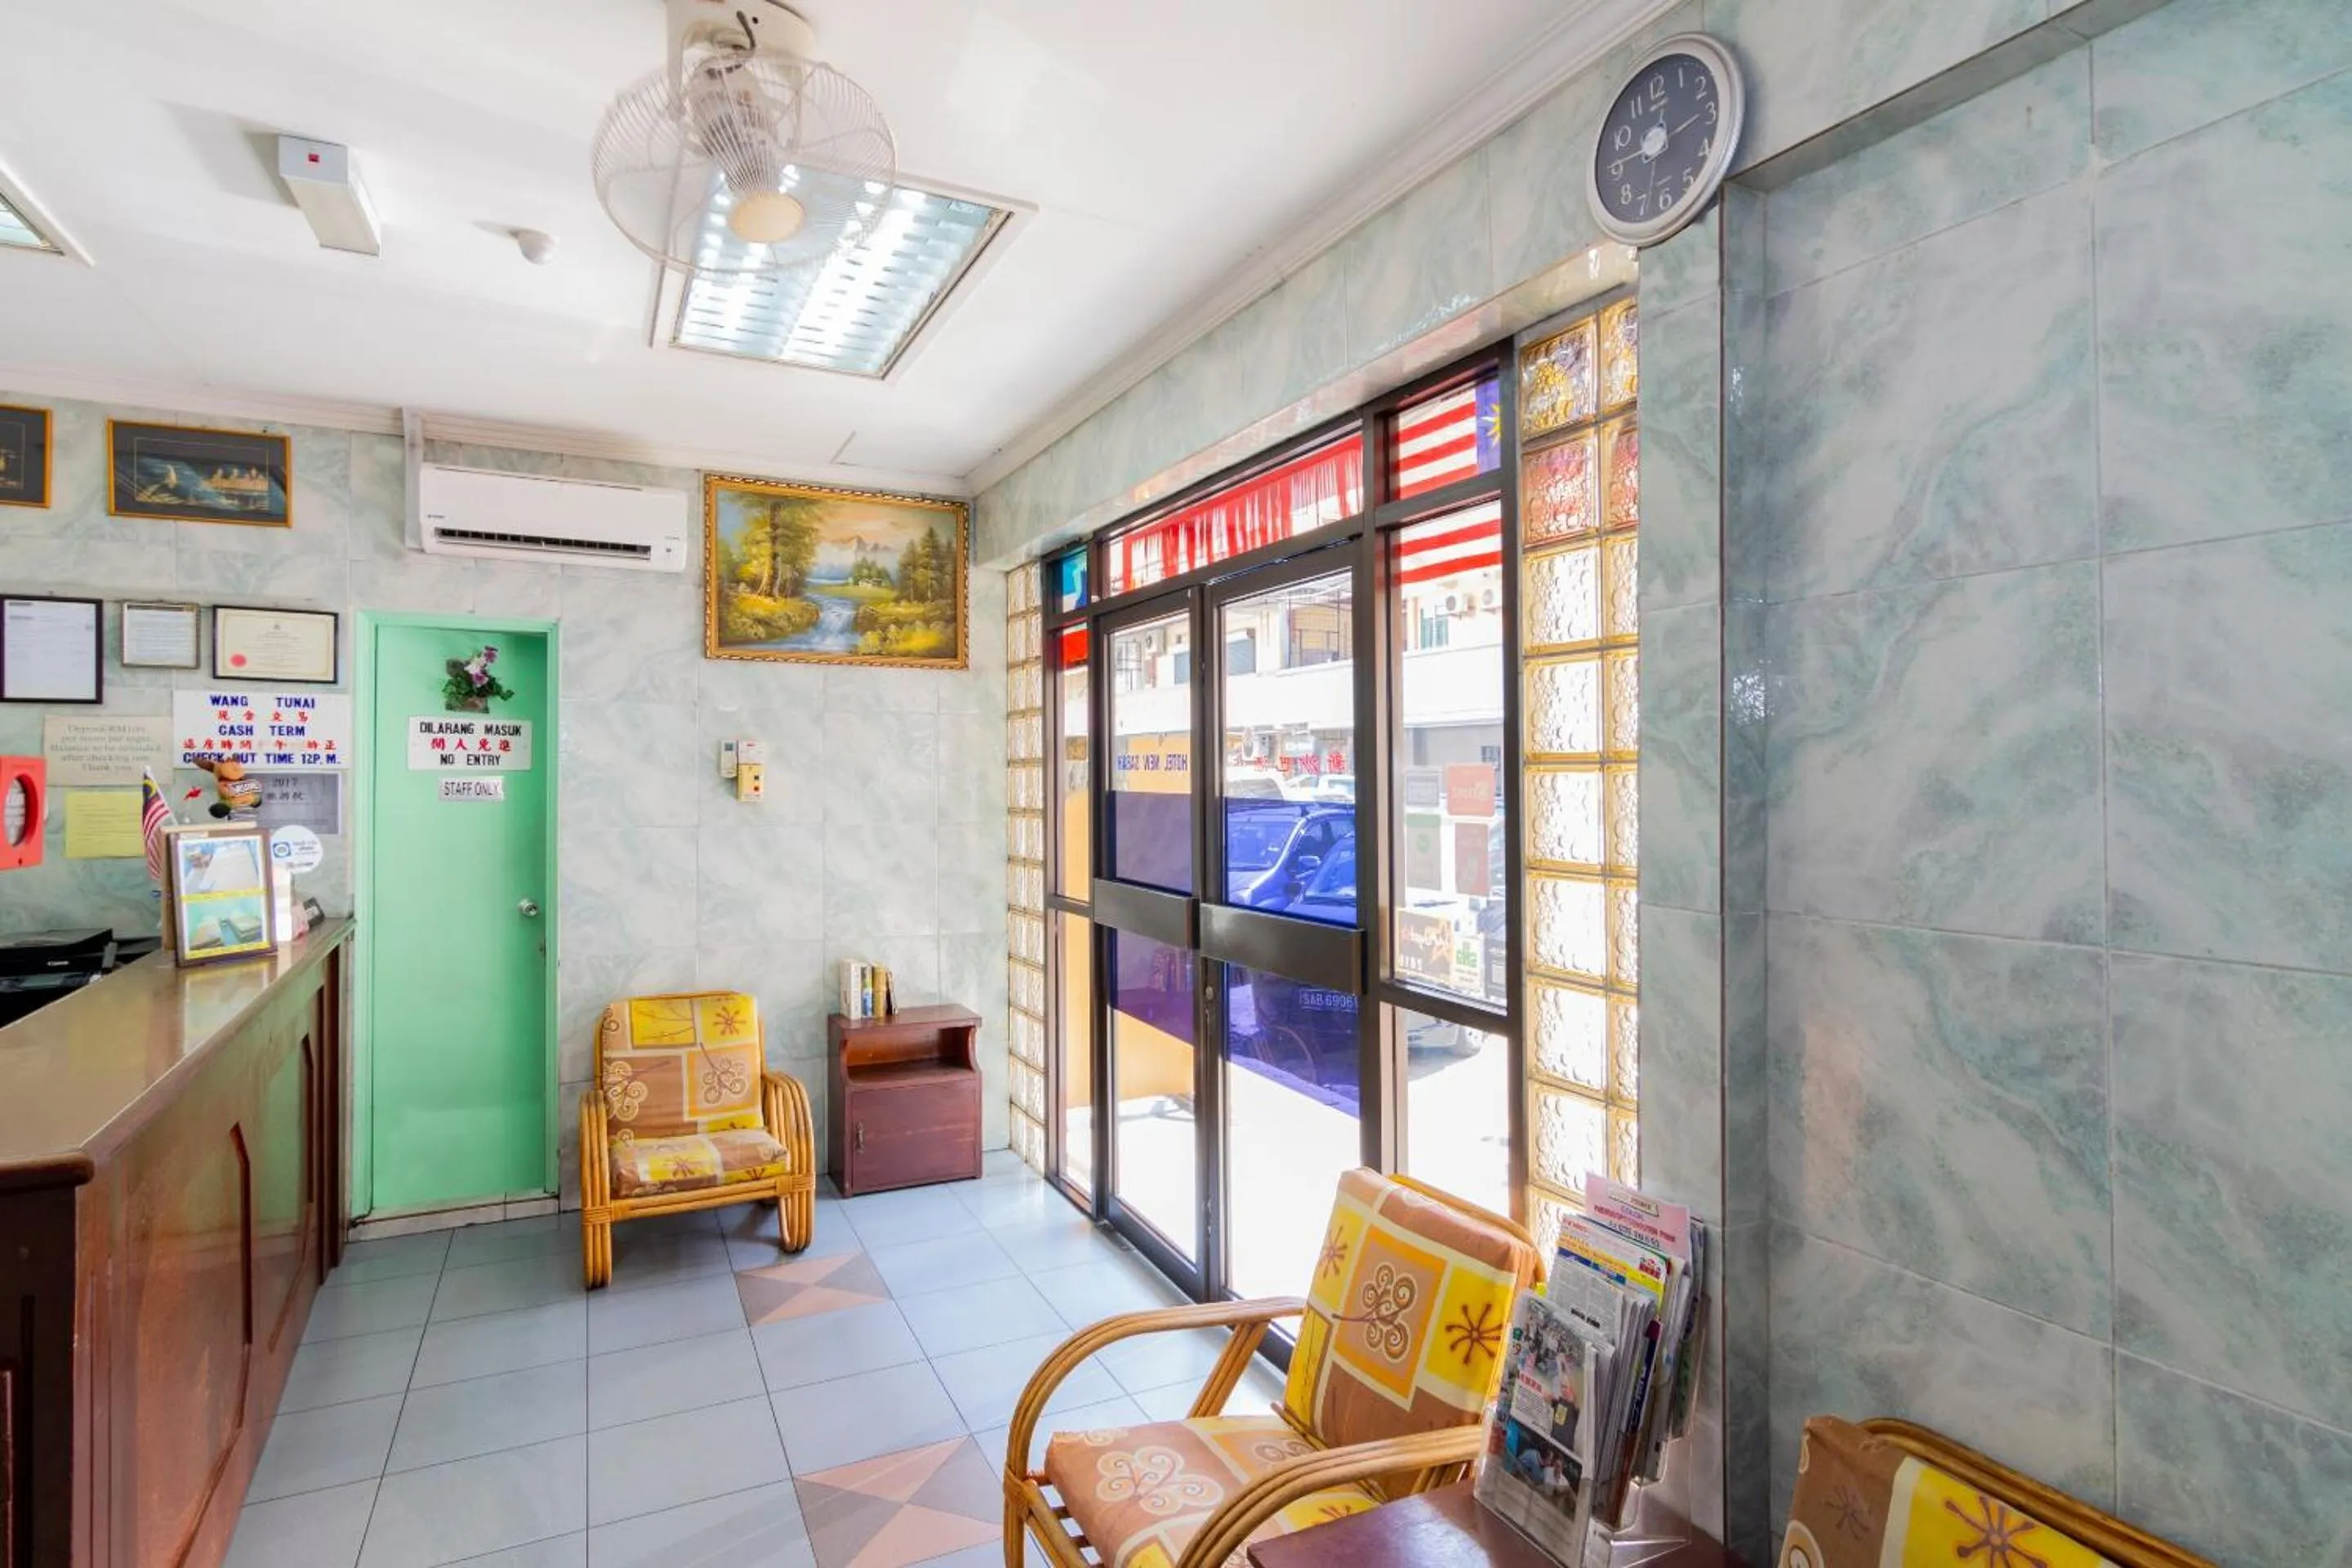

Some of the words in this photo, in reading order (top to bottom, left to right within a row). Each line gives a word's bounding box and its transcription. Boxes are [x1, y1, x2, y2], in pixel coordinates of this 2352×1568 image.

[1649, 74, 1665, 100] 12
[1677, 68, 1684, 89] 1
[1693, 75, 1708, 100] 2
[1629, 95, 1643, 120] 11
[1704, 101, 1717, 125] 3
[1614, 124, 1632, 151] 10
[1697, 137, 1712, 158] 4
[1609, 163, 1624, 181] 9
[1682, 166, 1695, 191] 5
[1620, 183, 1632, 205] 8
[1636, 193, 1647, 216] 7
[1659, 187, 1673, 210] 6
[210, 695, 249, 706] WANG
[276, 697, 315, 709] TUNAI
[218, 725, 253, 736] CASH
[269, 725, 305, 736] TERM
[420, 721, 474, 734] DILARANG
[484, 724, 522, 736] MASUK
[183, 752, 225, 764] CHECK
[231, 752, 256, 764] OUT
[265, 753, 295, 764] TIME
[440, 753, 455, 765] NO
[466, 754, 501, 766] ENTRY
[443, 782, 474, 795] STAFF
[474, 782, 500, 795] ONLY
